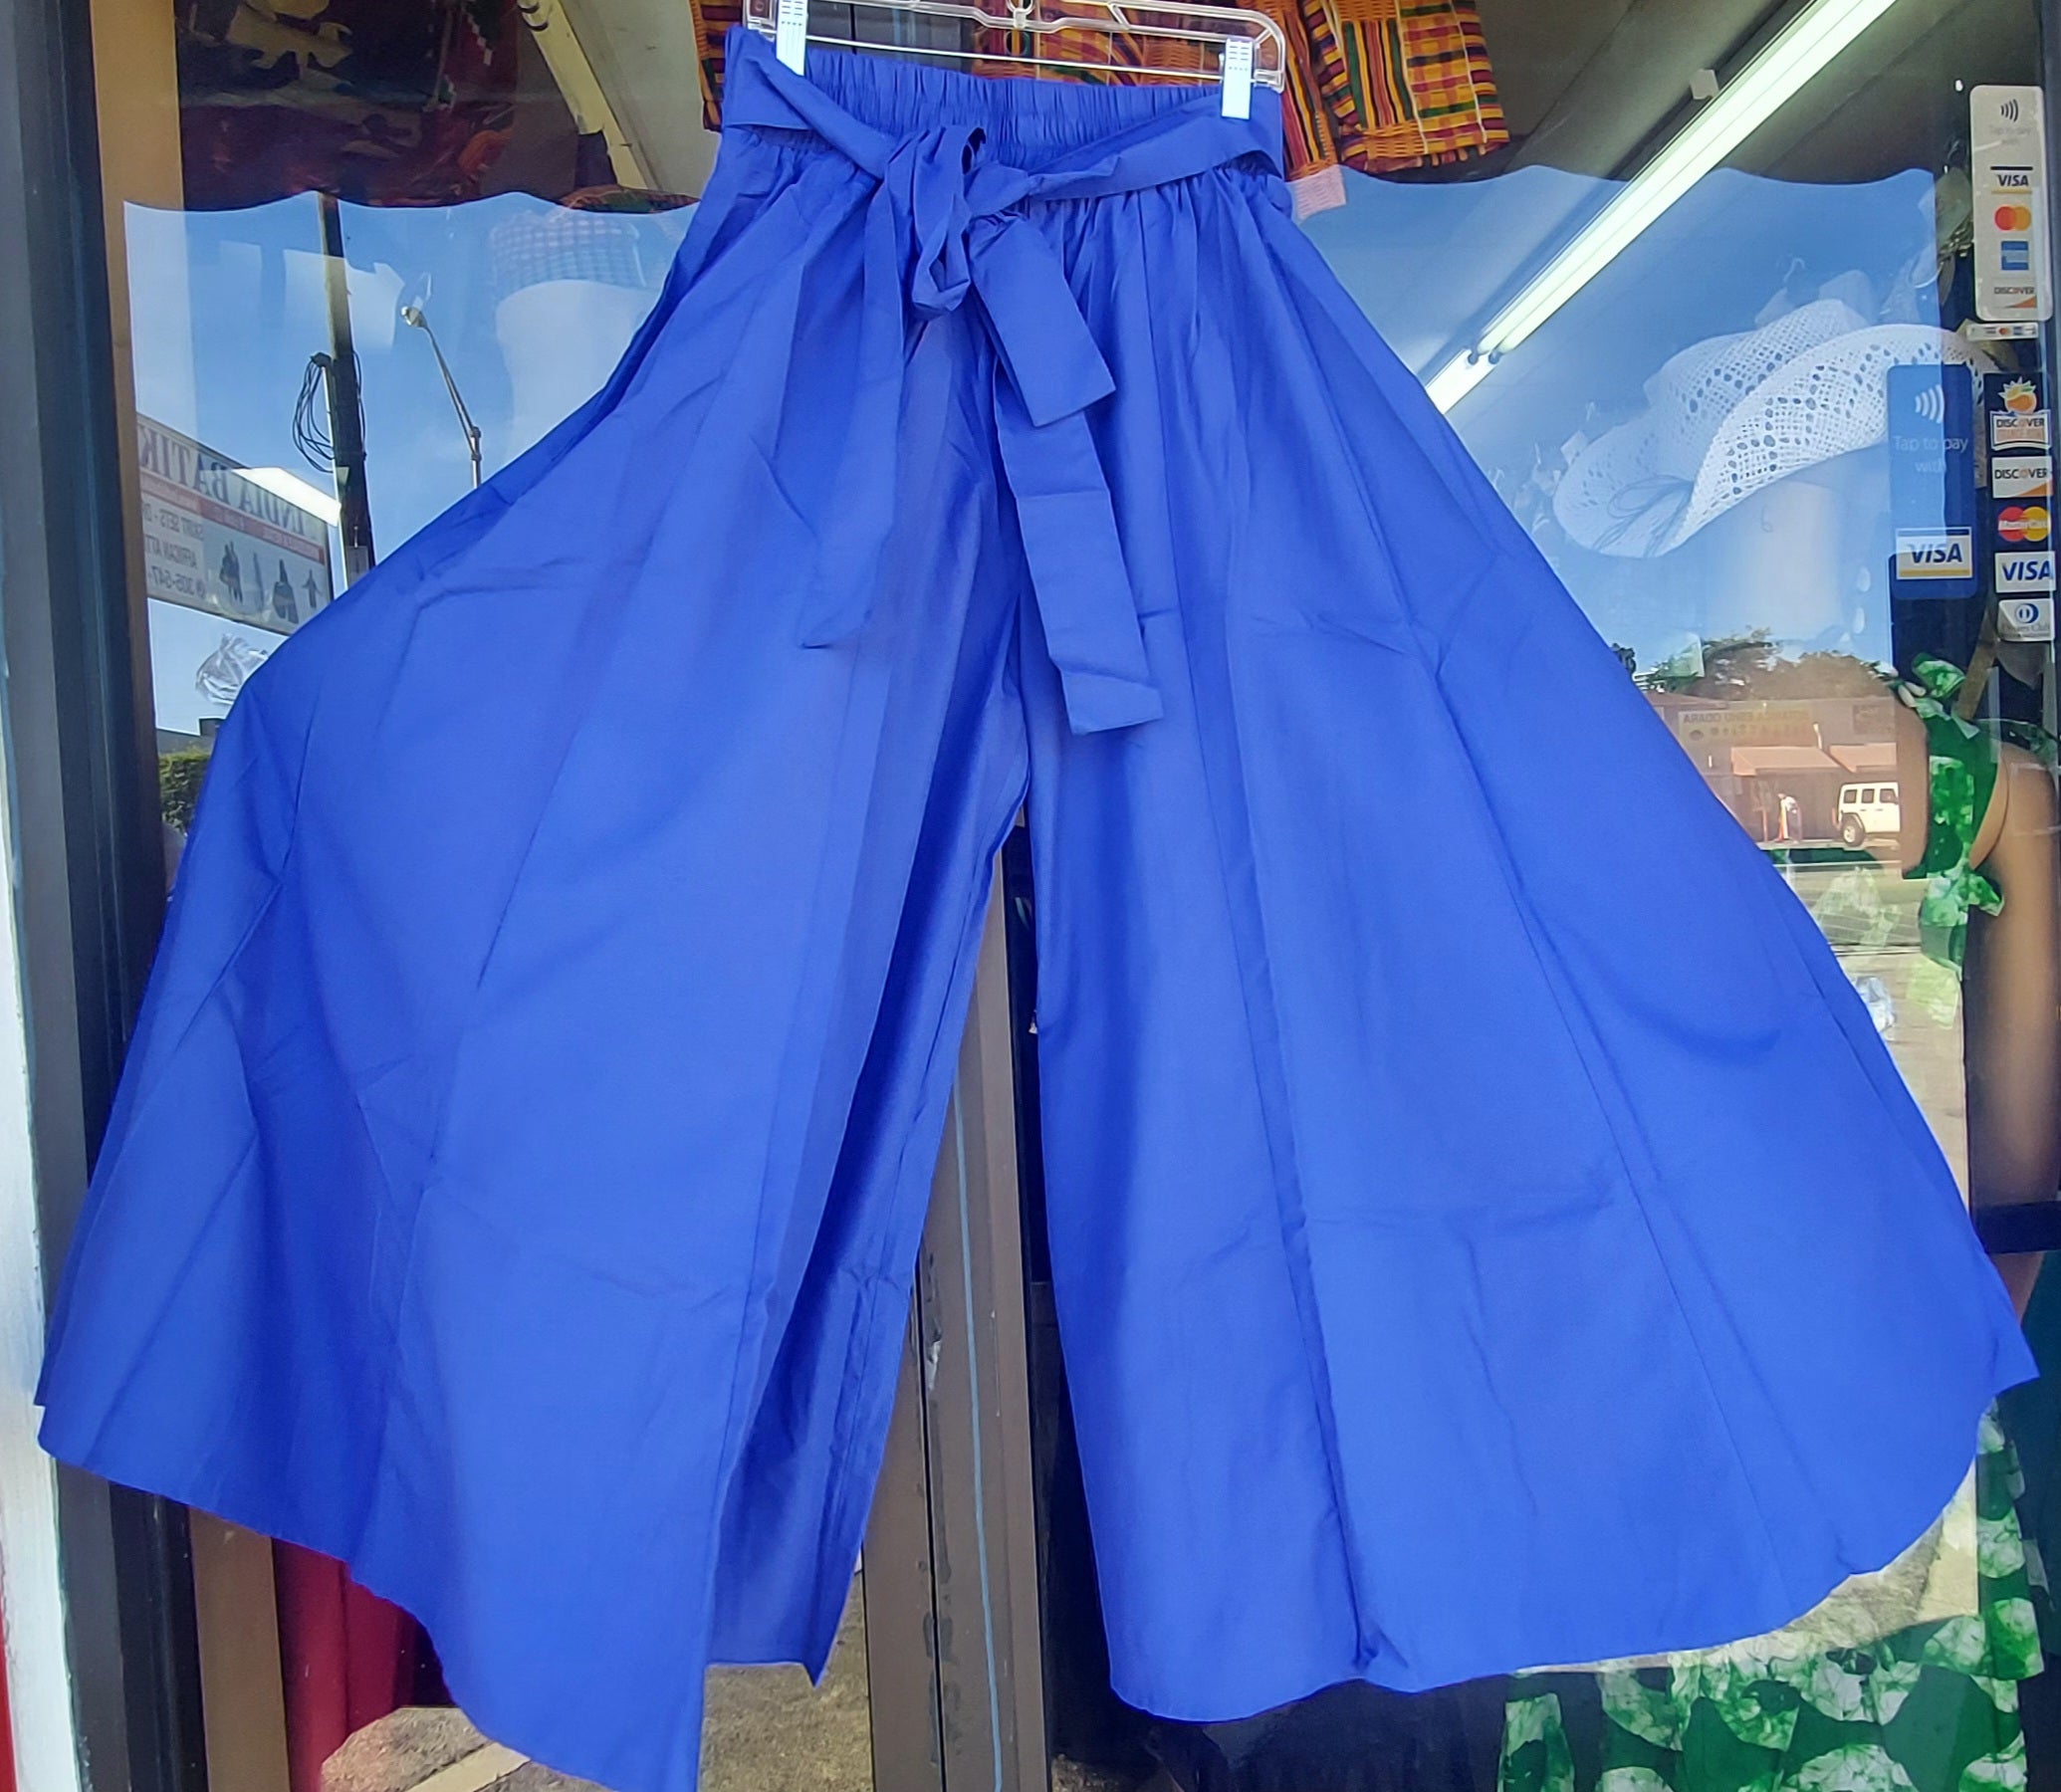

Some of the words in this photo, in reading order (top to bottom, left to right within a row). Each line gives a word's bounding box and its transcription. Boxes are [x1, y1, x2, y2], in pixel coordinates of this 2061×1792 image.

[1997, 174, 2029, 187] VISA
[1993, 286, 2035, 295] DISCOVER
[1996, 417, 2045, 428] DISCOVER
[1894, 435, 1918, 451] Tap
[1923, 436, 1939, 450] to
[1945, 438, 1969, 454] pay
[1994, 468, 2048, 480] DISCOVER
[1909, 543, 1963, 563] VISA
[2002, 560, 2053, 581] VISA
